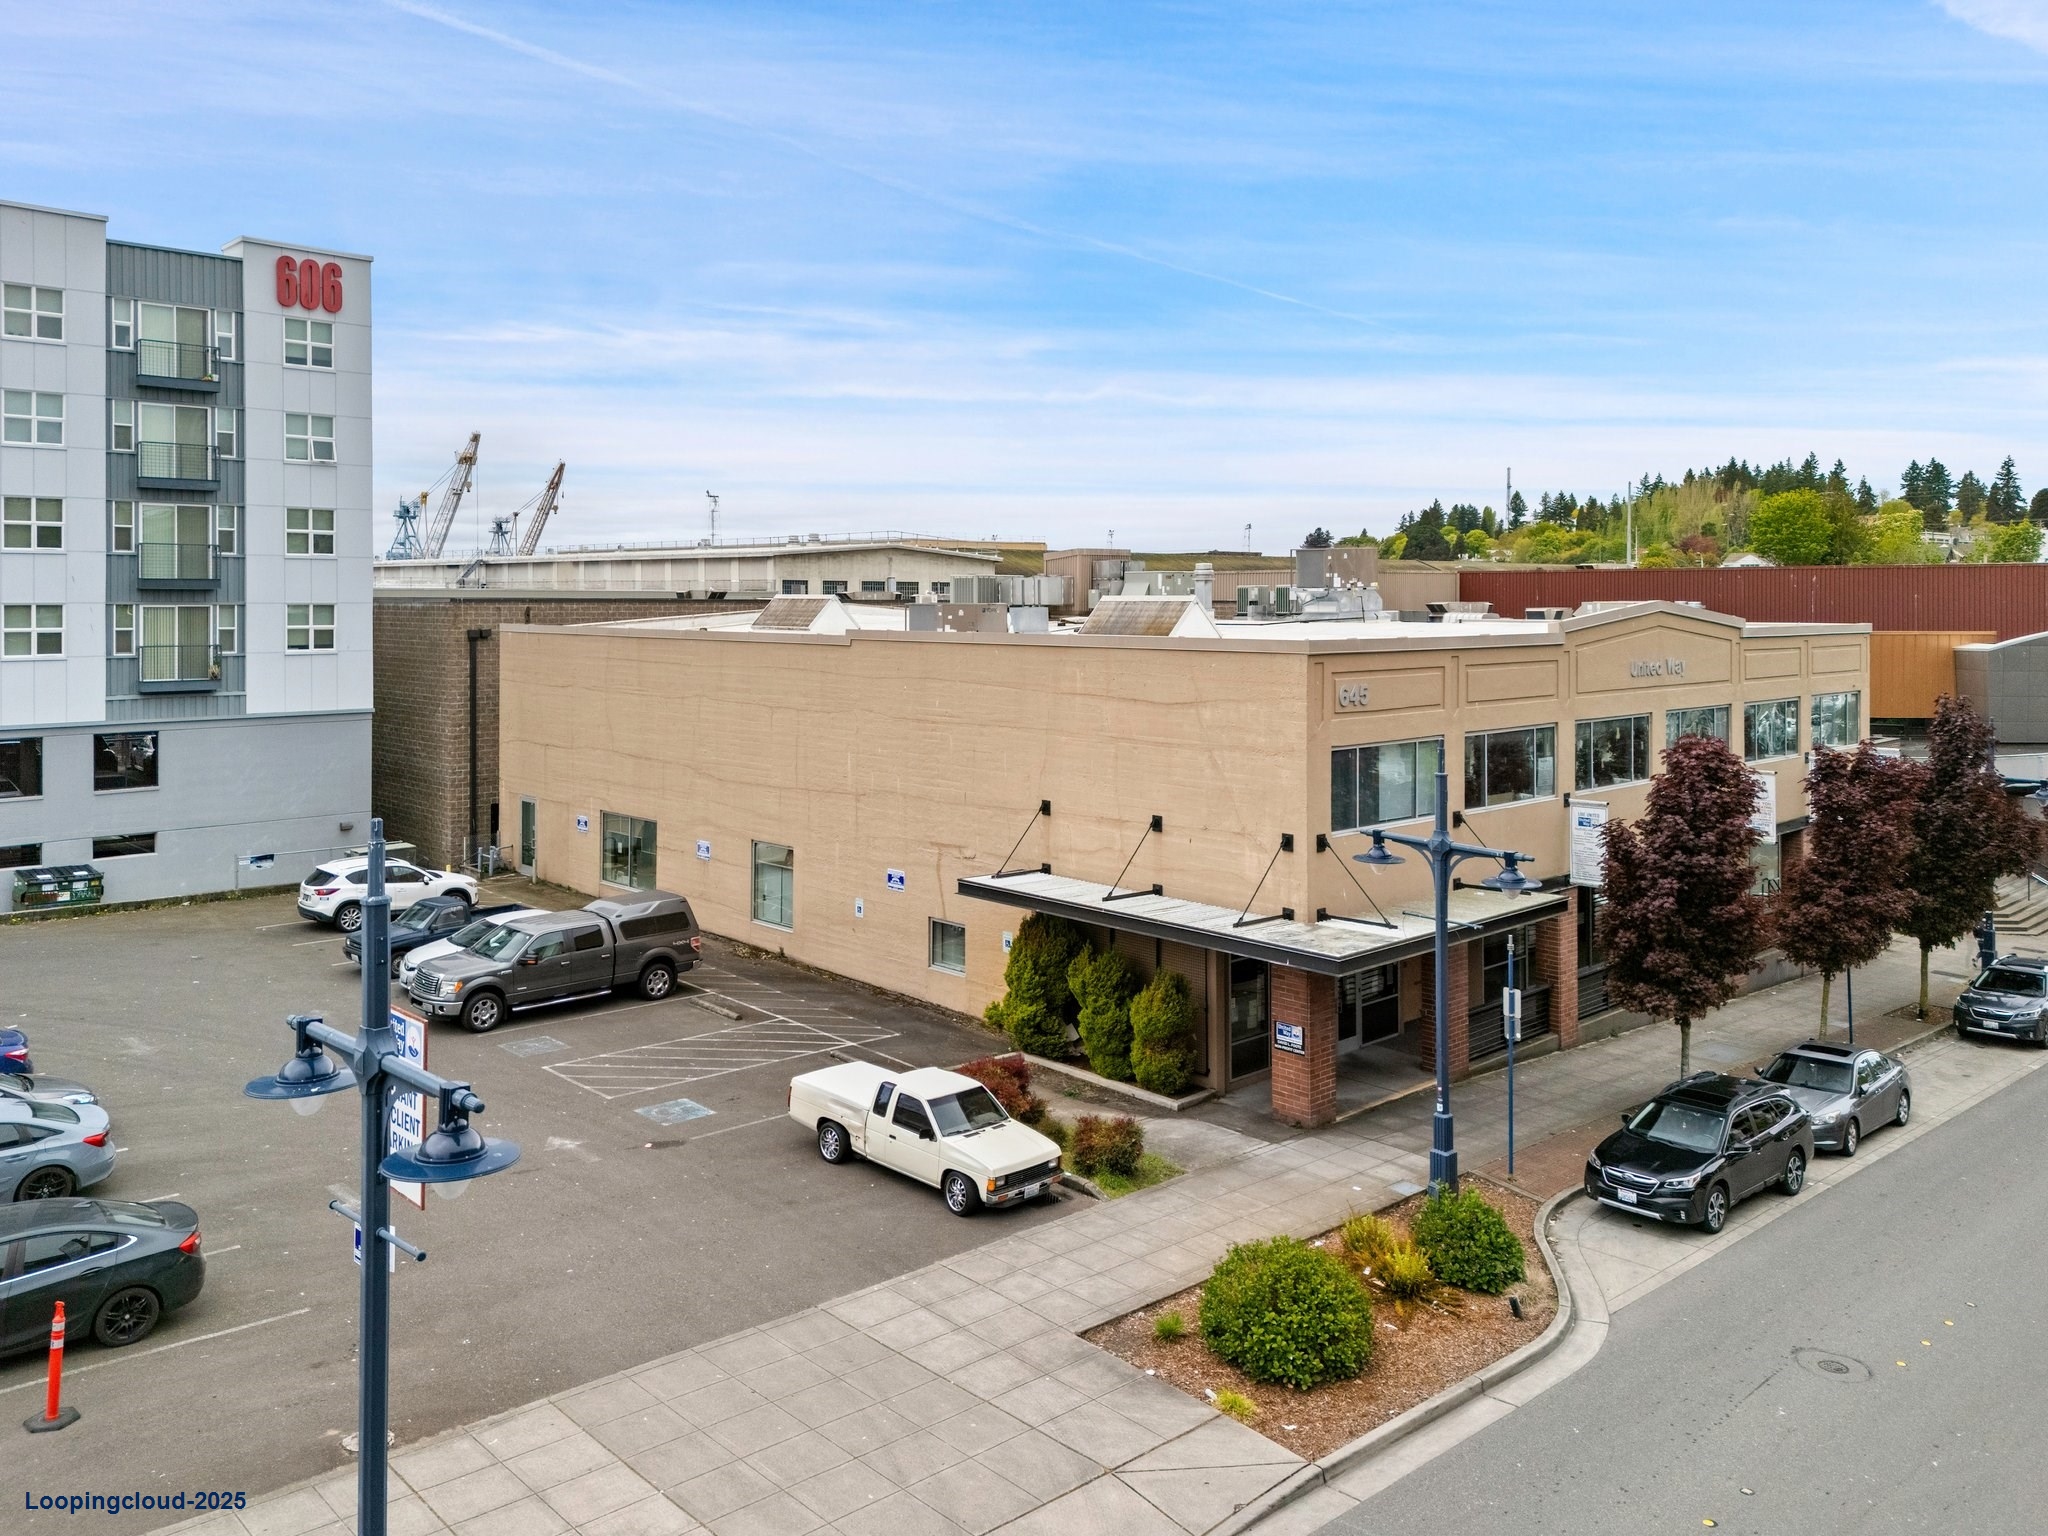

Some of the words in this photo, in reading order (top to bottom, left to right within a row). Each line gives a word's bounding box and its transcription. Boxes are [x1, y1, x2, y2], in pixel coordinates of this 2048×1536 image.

[276, 255, 343, 313] 606
[1339, 684, 1369, 707] 645
[390, 1106, 420, 1138] CLIENT
